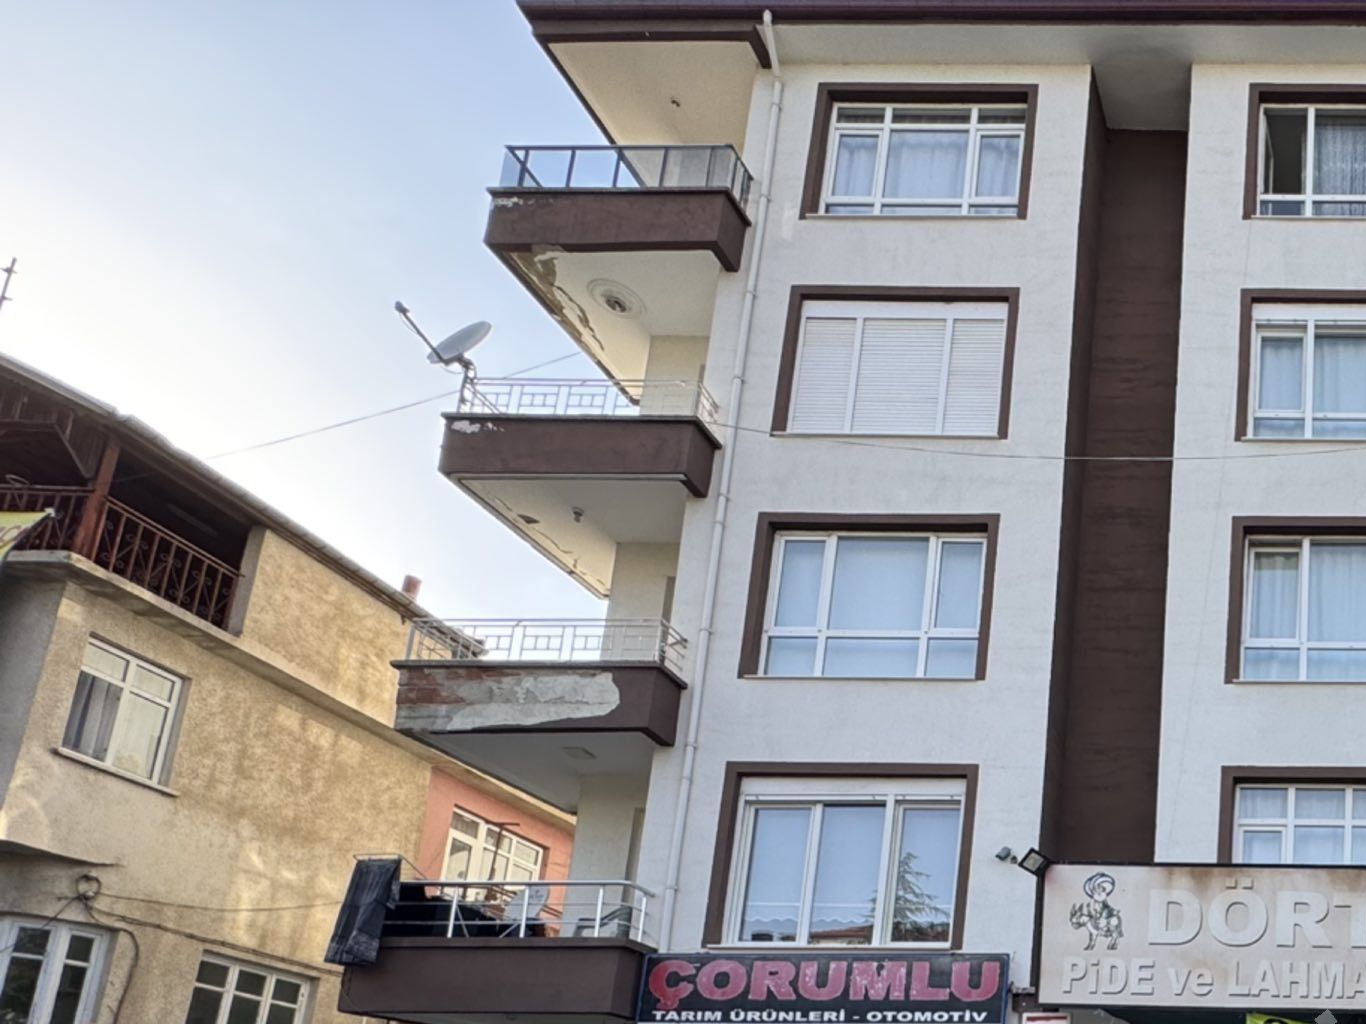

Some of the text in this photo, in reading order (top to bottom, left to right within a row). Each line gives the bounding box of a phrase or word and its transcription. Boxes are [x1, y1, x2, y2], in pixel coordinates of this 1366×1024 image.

[650, 959, 1000, 1010] ÇORUMLU
[1169, 964, 1214, 997] ve
[652, 1010, 722, 1021] TARIM
[730, 1008, 845, 1022] ÜRÜNLERİ
[866, 1009, 988, 1022] OTOMOTİV
